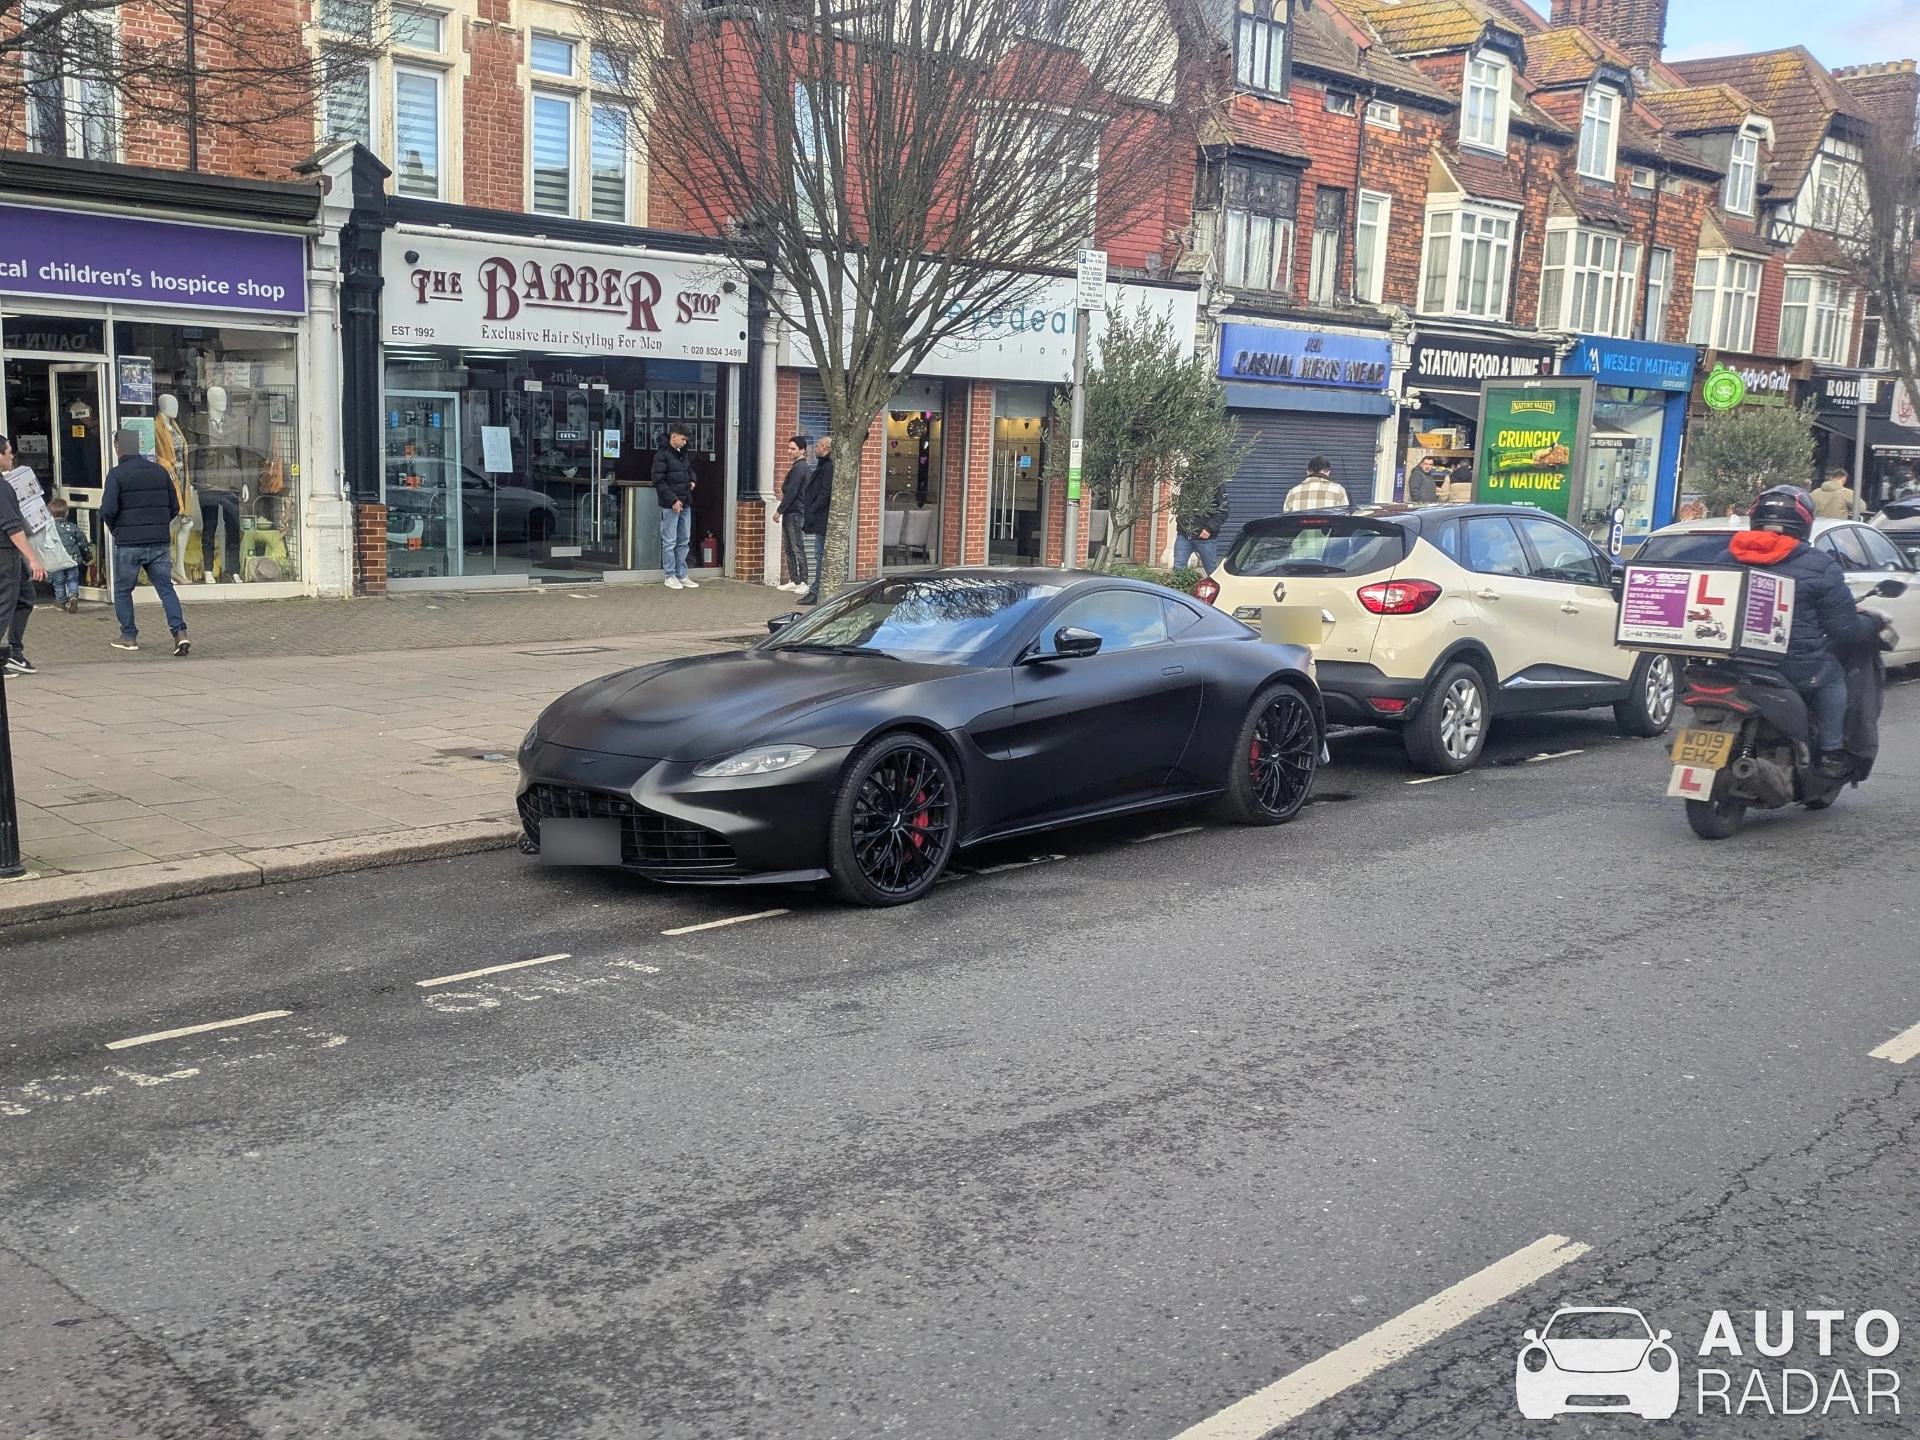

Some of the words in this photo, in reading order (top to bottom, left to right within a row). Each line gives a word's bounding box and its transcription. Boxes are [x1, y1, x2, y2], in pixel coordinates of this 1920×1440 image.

[0, 259, 28, 278] cal
[38, 262, 142, 287] children's
[150, 270, 230, 296] hospice
[236, 278, 285, 302] shop
[411, 268, 463, 304] THE
[478, 256, 662, 332] BARBER
[675, 291, 721, 323] STOP
[391, 325, 411, 336] EST
[414, 326, 435, 338] 1992
[481, 324, 539, 342] Exclusive
[542, 328, 569, 344] Hair
[572, 331, 614, 350] Styling
[618, 334, 637, 348] For
[640, 335, 662, 352] Men
[682, 345, 689, 354] T:
[691, 346, 704, 355] 020
[706, 346, 722, 356] 8524
[724, 347, 742, 357] 3499
[1419, 347, 1468, 377] STATION
[1468, 352, 1500, 379] FOOD
[1500, 355, 1509, 376] &
[1510, 357, 1539, 376] WINE
[1232, 349, 1294, 378] CASUAL
[1343, 360, 1386, 385] WEAR
[1603, 353, 1642, 373] WESLEY
[1644, 358, 1690, 377] MATTHEW
[1729, 365, 1768, 392] Bddy's
[1523, 380, 1541, 388] global
[1513, 402, 1534, 411] NATURE
[1534, 402, 1554, 411] VALLEY
[1498, 430, 1562, 448] CRUNCHY
[1489, 473, 1506, 488] BY
[1509, 473, 1561, 490] NATURE
[1695, 574, 1725, 606] L
[1776, 580, 1789, 612] L
[1681, 746, 1719, 764] EHZ
[1680, 768, 1701, 792] L
